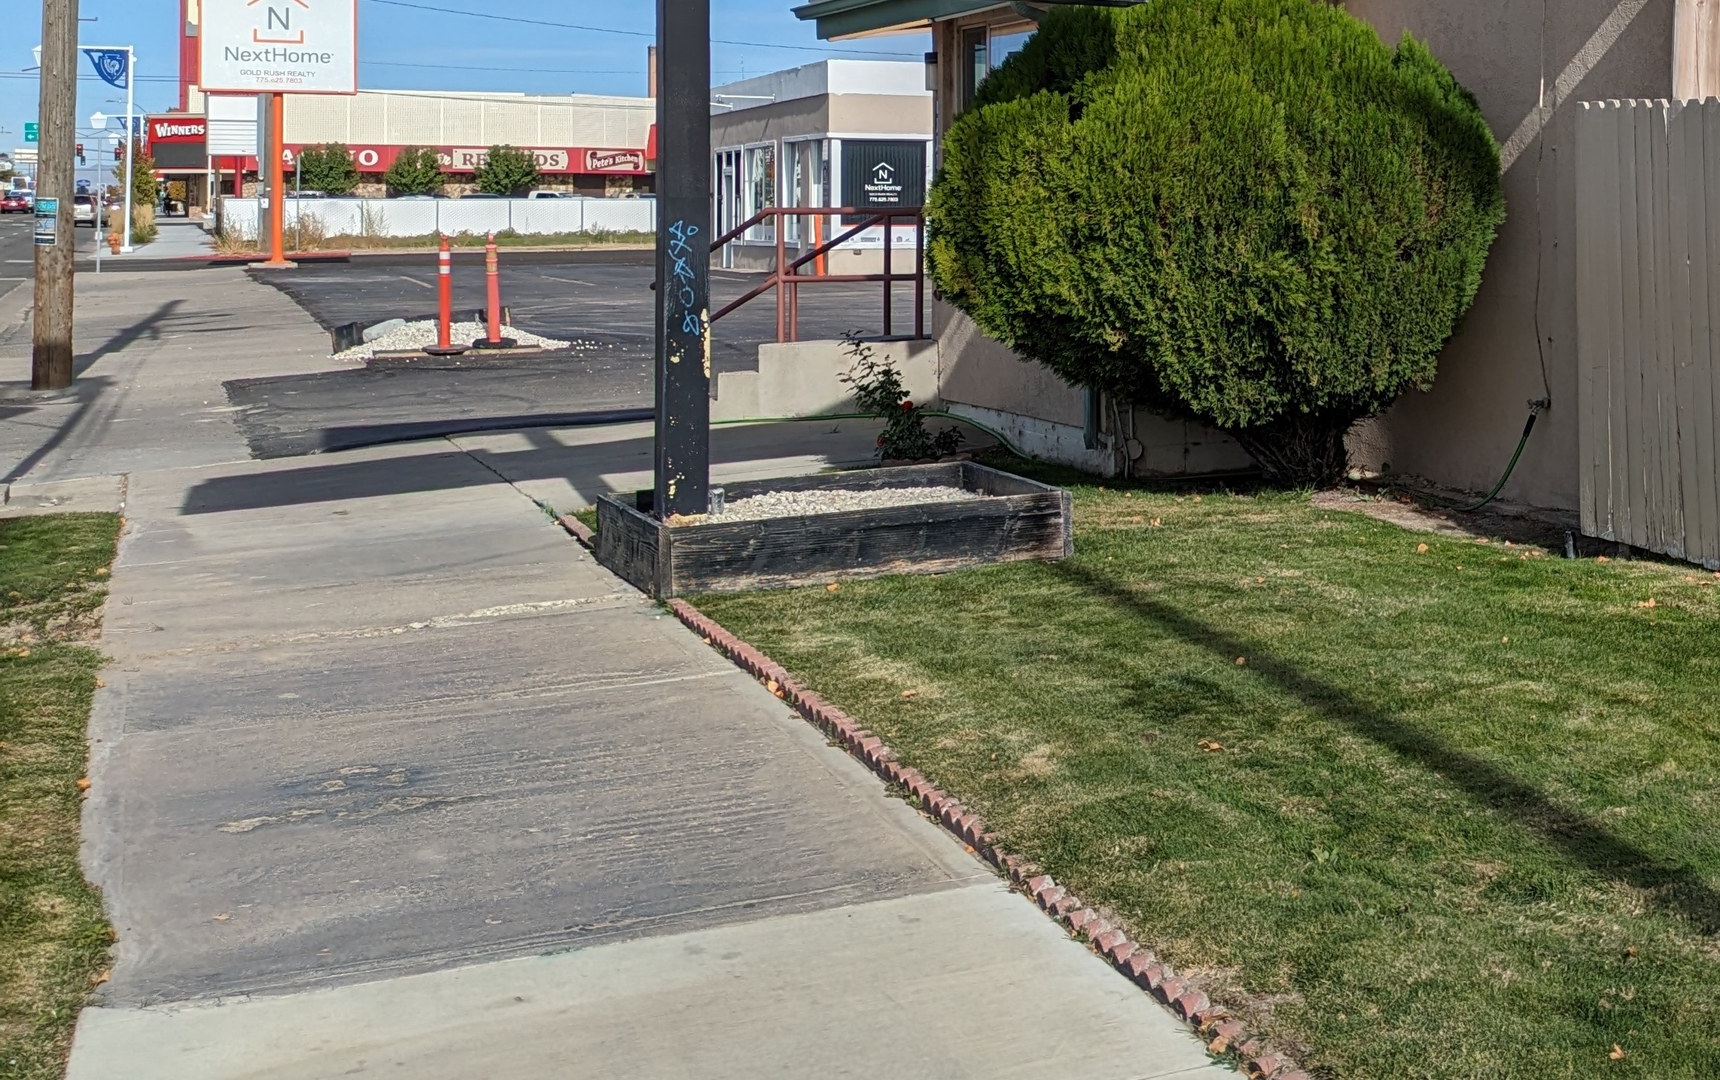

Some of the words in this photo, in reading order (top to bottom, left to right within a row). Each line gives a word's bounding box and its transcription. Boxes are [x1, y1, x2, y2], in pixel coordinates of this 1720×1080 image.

[224, 46, 332, 64] NextHome
[287, 70, 316, 78] REALTY
[154, 122, 205, 138] WINNERS
[592, 156, 614, 169] Pete's
[615, 153, 639, 164] Kitchen
